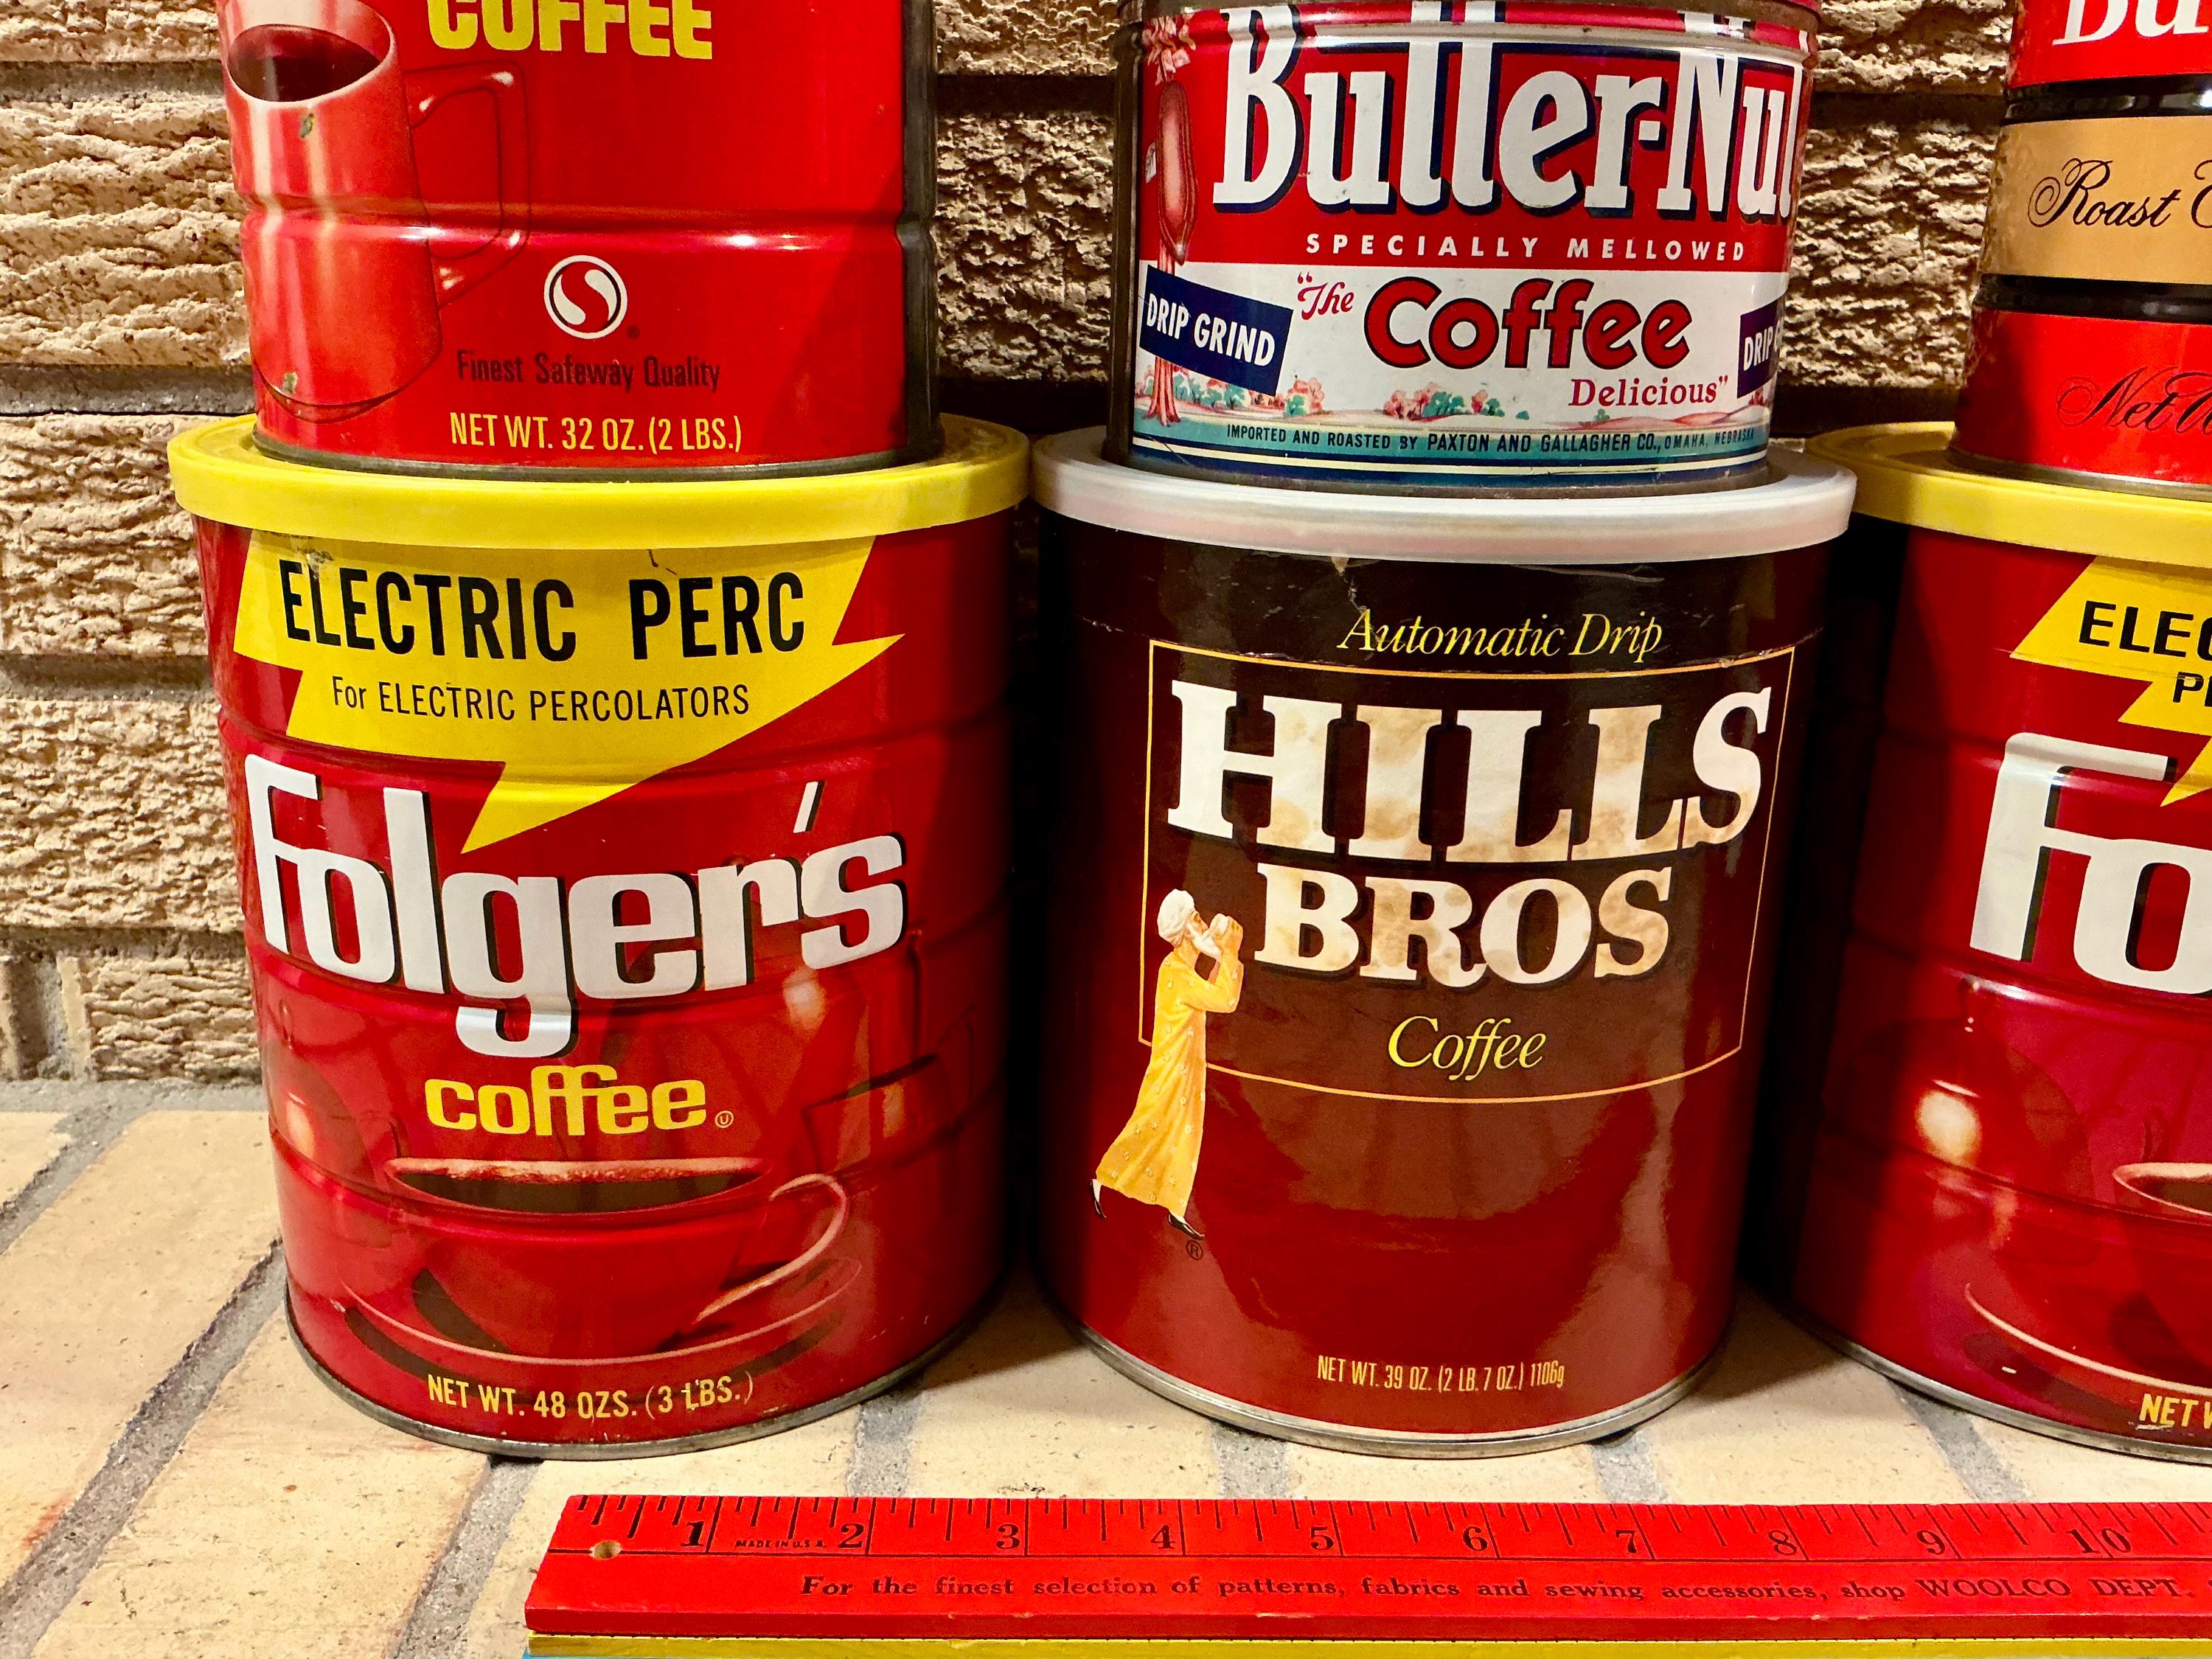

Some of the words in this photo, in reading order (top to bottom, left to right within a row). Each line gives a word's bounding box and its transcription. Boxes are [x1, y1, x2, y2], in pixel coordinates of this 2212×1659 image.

[428, 0, 712, 60] COFFEE
[2028, 158, 2181, 228] Roast
[1307, 233, 1537, 258] SPECIALLY
[1568, 237, 1745, 261] MELLOWED
[1147, 293, 1189, 339] DRIP
[1194, 313, 1276, 366] GRIND
[1364, 276, 1693, 370] Coffee
[456, 349, 524, 383] Finest
[535, 352, 634, 393] Safeway
[644, 355, 720, 393] Quality
[1568, 375, 1728, 406] Delicious"
[2056, 366, 2177, 431] Net
[451, 412, 497, 445] NET
[504, 416, 553, 449] WT.
[562, 417, 592, 450] 32
[602, 419, 644, 451] OZ.
[649, 417, 672, 455] (2
[682, 416, 742, 453] LBS.)
[1227, 424, 1287, 442] IMPORTED
[1293, 431, 1320, 445] AND
[1327, 432, 1391, 450] ROASTED
[1399, 435, 1417, 451] BY
[1427, 434, 1490, 452] PAXTON
[1497, 434, 1531, 453] AND
[1540, 434, 1630, 452] GALLAGHER
[1714, 428, 1755, 445] NEBRASKA
[279, 559, 575, 663] ELECTRIC
[630, 571, 804, 660] PERC
[1338, 608, 1565, 657] Automatic
[1569, 611, 1663, 664] Drip
[332, 676, 365, 710] For
[379, 681, 515, 722] ELECTRIC
[530, 684, 750, 722] PERCOLATORS
[1167, 680, 1772, 863] HILLS
[244, 754, 908, 1058] Folger's
[1254, 863, 1672, 989] BROS
[1388, 1015, 1547, 1081] Coffee
[425, 1065, 706, 1136] coffee
[428, 1374, 469, 1409] NET
[479, 1384, 525, 1416] WT.
[534, 1391, 566, 1418] 48
[578, 1390, 637, 1419] OZS.
[645, 1385, 672, 1419] (3
[683, 1371, 754, 1411] LBS.)
[1318, 1355, 1346, 1382] NET
[1352, 1360, 1379, 1387] WT.
[1384, 1365, 1403, 1389] 39
[1409, 1366, 1432, 1391] OZ.
[1439, 1365, 1453, 1393] (2
[1458, 1367, 1478, 1392] LB.
[1484, 1367, 1492, 1391] 7
[1496, 1362, 1524, 1391] OZ.)
[1531, 1360, 1565, 1388] 1106g
[2139, 1394, 2199, 1428] NET
[681, 1520, 707, 1547] 1
[838, 1523, 864, 1548] 2
[995, 1524, 1020, 1549] 3
[1150, 1524, 1175, 1549] 4
[1310, 1526, 1334, 1551] 5
[1463, 1526, 1489, 1551] 6
[1614, 1530, 1639, 1554] 7
[1769, 1529, 1798, 1556] 8
[1917, 1529, 1947, 1556] 9
[2066, 1528, 2132, 1554] 10
[735, 1540, 771, 1548] MADE
[801, 1576, 854, 1596] For
[873, 1577, 918, 1596] the
[936, 1576, 1014, 1596] finest
[1033, 1576, 1158, 1596] selection
[1171, 1576, 1200, 1596] of
[1219, 1579, 1345, 1599] patterns,
[1362, 1576, 1461, 1597] fabrics
[1477, 1579, 1529, 1598] and
[1545, 1582, 1644, 1601] sewing
[1660, 1582, 1828, 1601] accessories,
[1841, 1581, 1905, 1601] shop
[1915, 1578, 2072, 1598] WOOLCO
[2089, 1579, 2195, 1599] DEPT.
